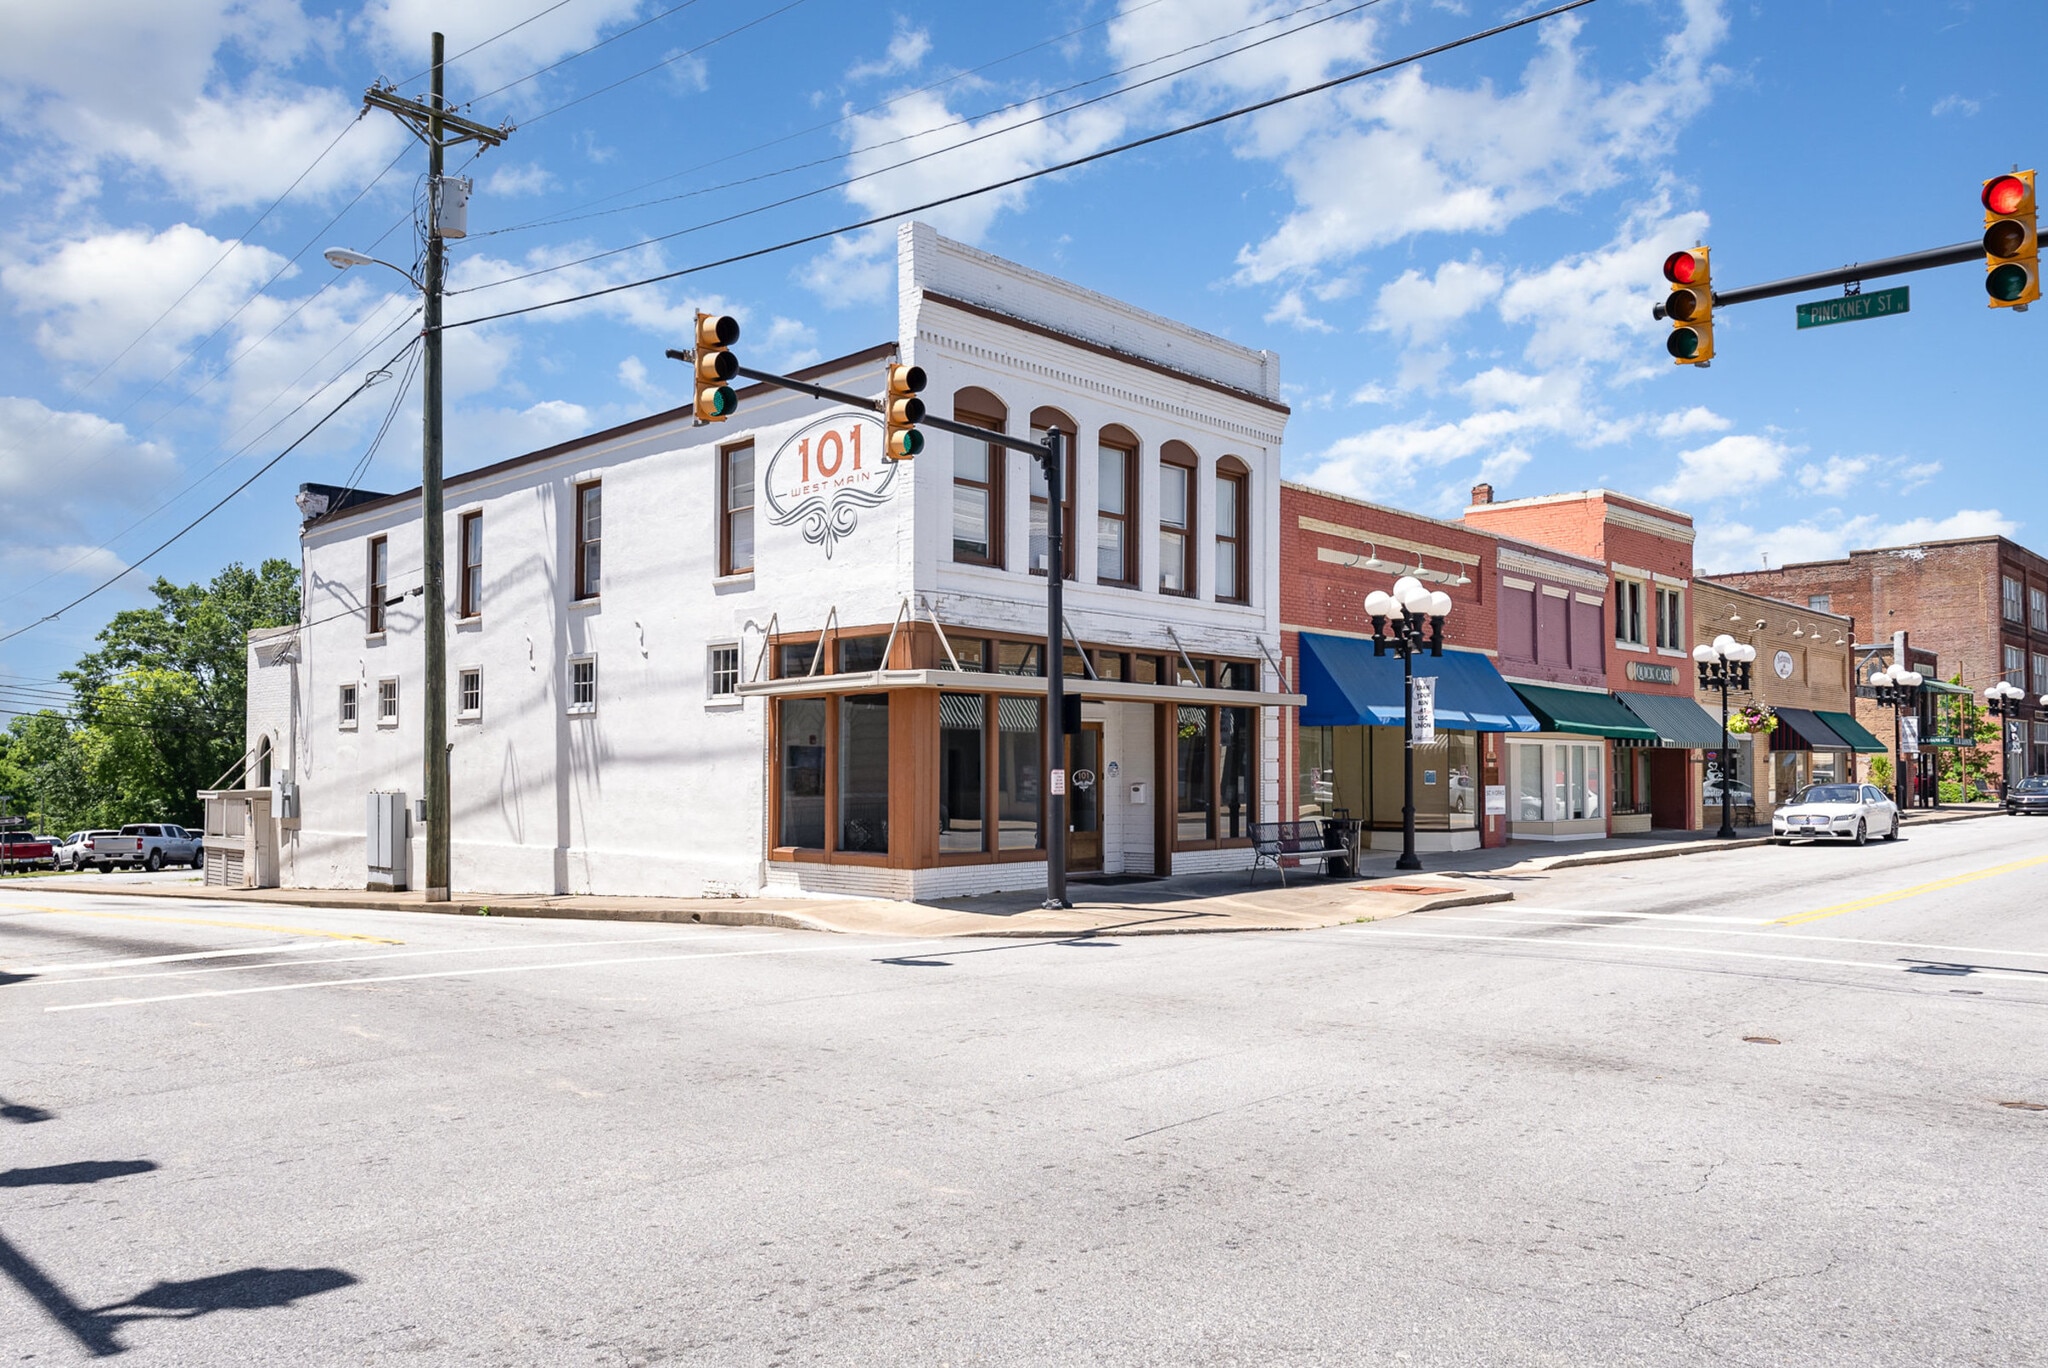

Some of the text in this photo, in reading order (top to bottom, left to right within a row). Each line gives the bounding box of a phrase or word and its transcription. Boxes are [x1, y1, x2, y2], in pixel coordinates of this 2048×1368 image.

[1811, 298, 1871, 323] PINCKNEY
[1878, 294, 1892, 312] ST
[1898, 302, 1904, 310] N
[798, 424, 862, 483] 101
[791, 472, 870, 497] WEST MAIN
[1636, 665, 1672, 681] QUICK CASH
[1078, 771, 1090, 780] 101
